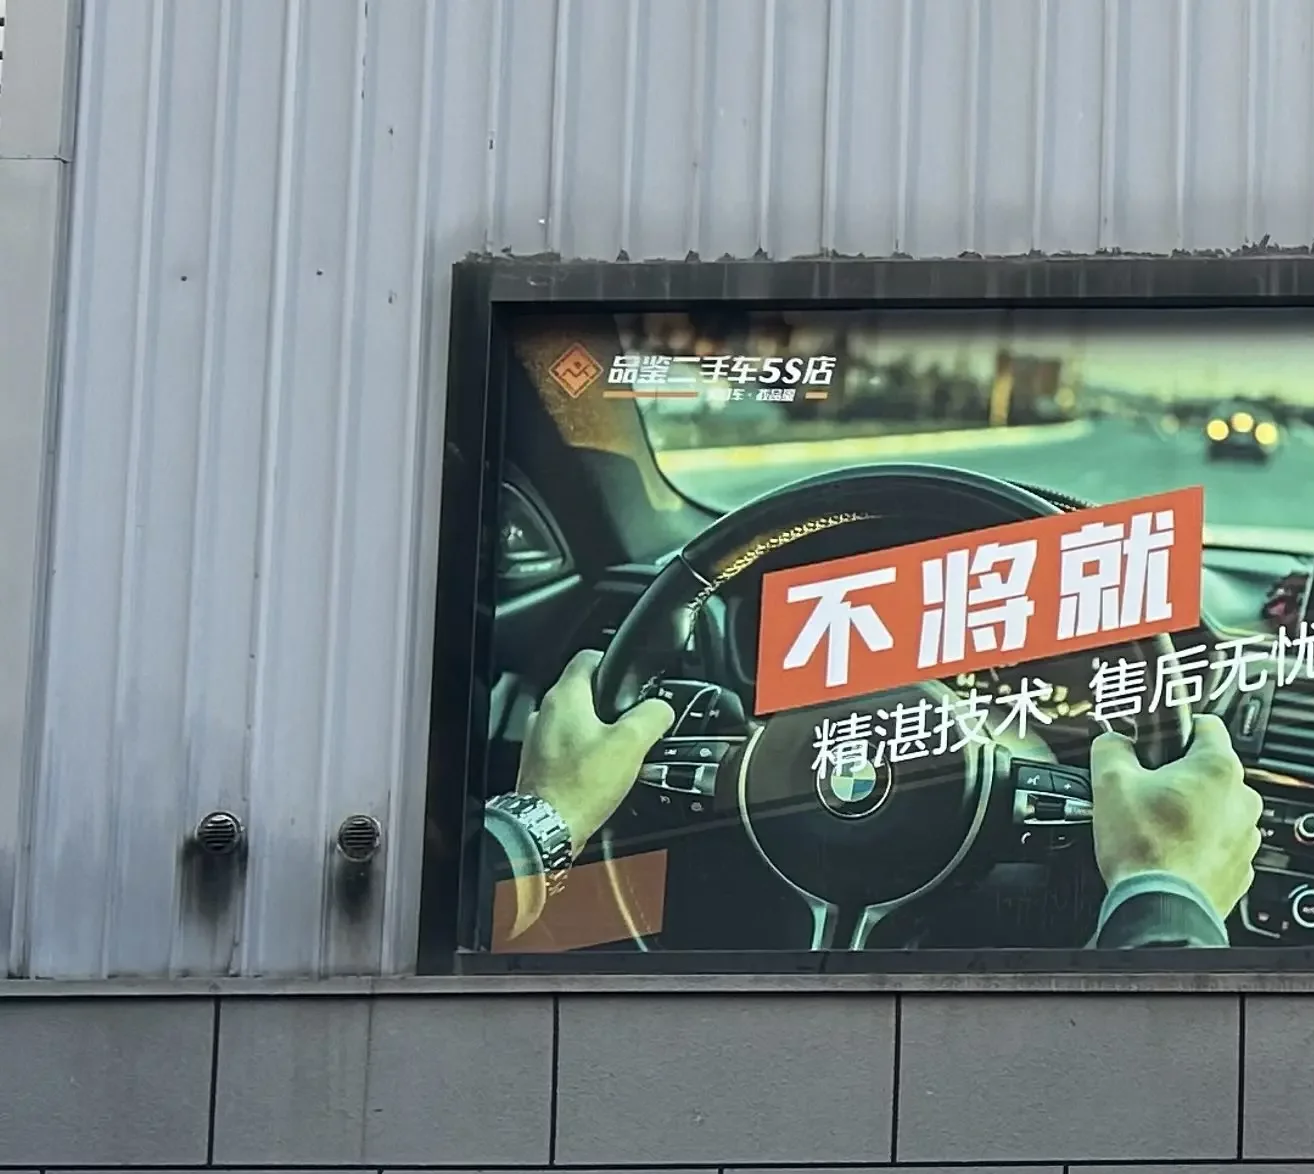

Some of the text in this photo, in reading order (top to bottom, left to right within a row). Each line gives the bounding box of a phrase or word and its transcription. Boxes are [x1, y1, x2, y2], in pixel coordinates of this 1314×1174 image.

[607, 355, 837, 386] 品鉴二手车5S店
[781, 508, 1176, 690] 不将就
[810, 676, 1054, 782] 精湛技术
